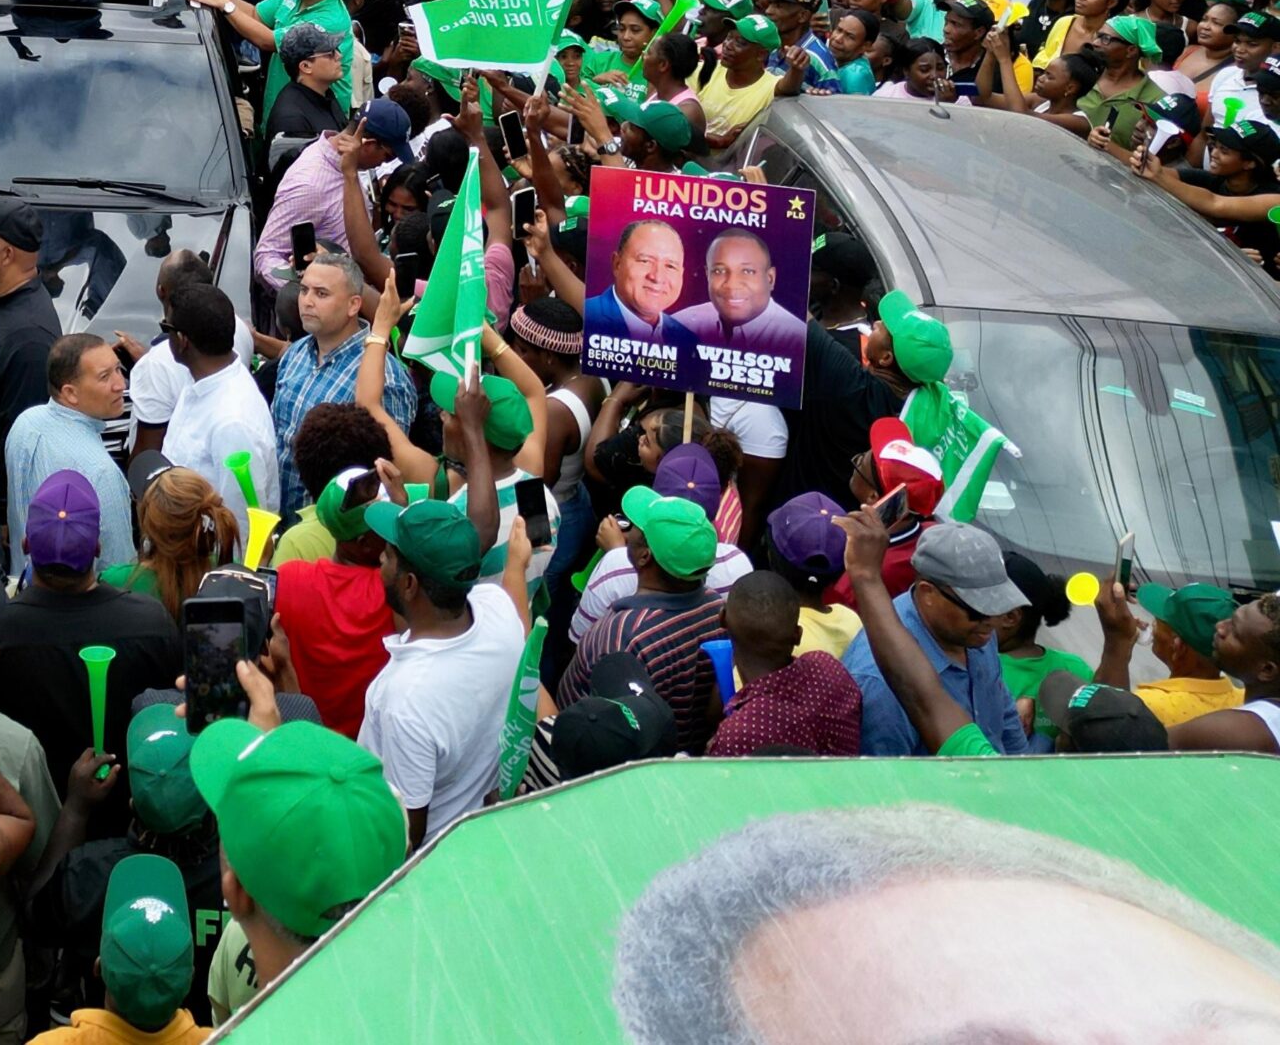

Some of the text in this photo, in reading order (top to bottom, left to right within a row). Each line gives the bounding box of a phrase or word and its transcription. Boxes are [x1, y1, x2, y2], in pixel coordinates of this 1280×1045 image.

[634, 177, 767, 213] ¡UNIDOS
[633, 199, 766, 228] PARA GANAR!
[787, 211, 806, 219] PLD
[588, 334, 678, 361] CRISTIAN
[588, 349, 678, 372] BERROA ALCALDE
[696, 345, 792, 373] WILSON
[588, 361, 632, 373] GUERRA
[710, 362, 774, 388] DESI
[708, 381, 738, 391] REGIDOR
